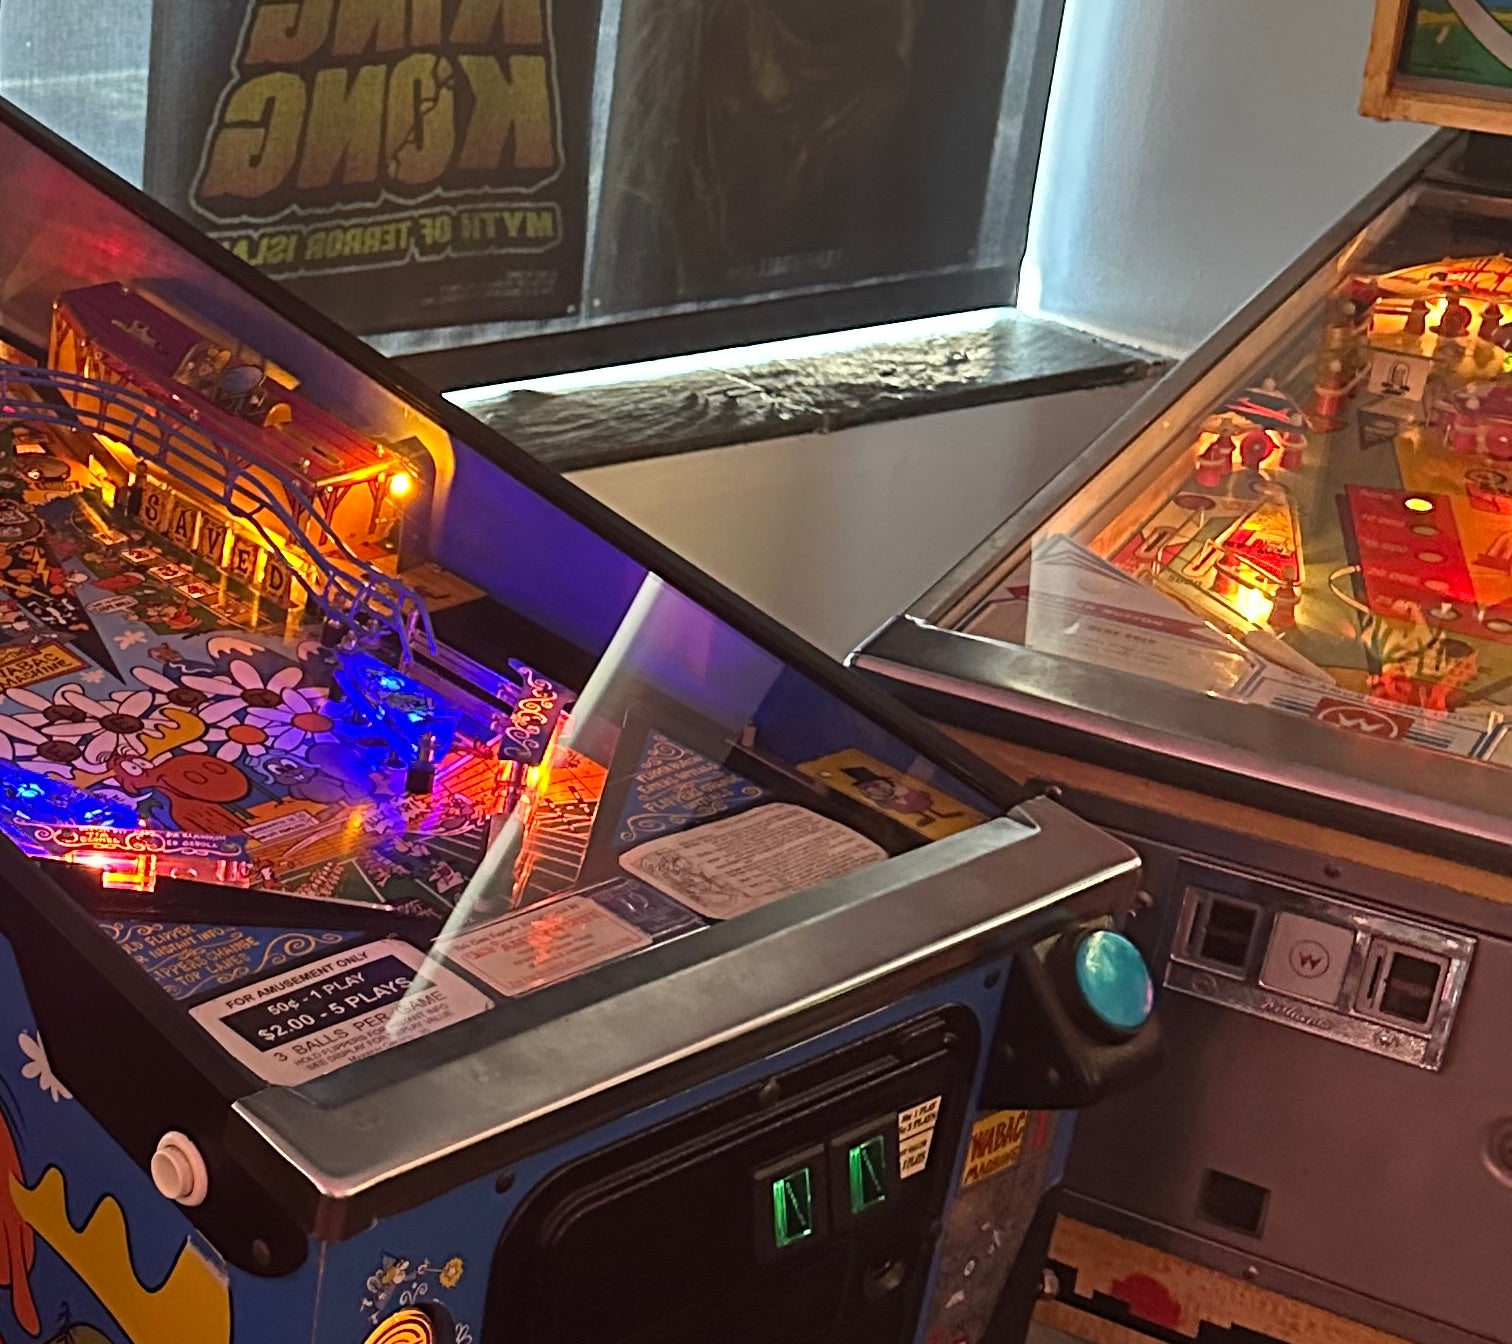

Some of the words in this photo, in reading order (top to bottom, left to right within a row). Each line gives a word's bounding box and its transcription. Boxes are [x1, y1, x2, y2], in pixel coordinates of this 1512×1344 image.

[147, 925, 195, 947] FLIPPER
[176, 972, 200, 986] TOP
[205, 953, 251, 974] LANES
[226, 994, 256, 1009] FOR
[257, 963, 335, 998] AMUSEMENT
[337, 952, 369, 968] ONLY
[267, 999, 299, 1016] 50¢
[310, 990, 322, 1000] 1
[322, 972, 366, 996] PLAY
[257, 1013, 315, 1042] $2.00
[328, 1002, 345, 1015] 5
[344, 976, 412, 1008] PLAYS
[273, 1052, 288, 1062] 3
[292, 1028, 349, 1055] BALLS
[353, 1012, 387, 1032] PER
[397, 990, 446, 1014] GAME
